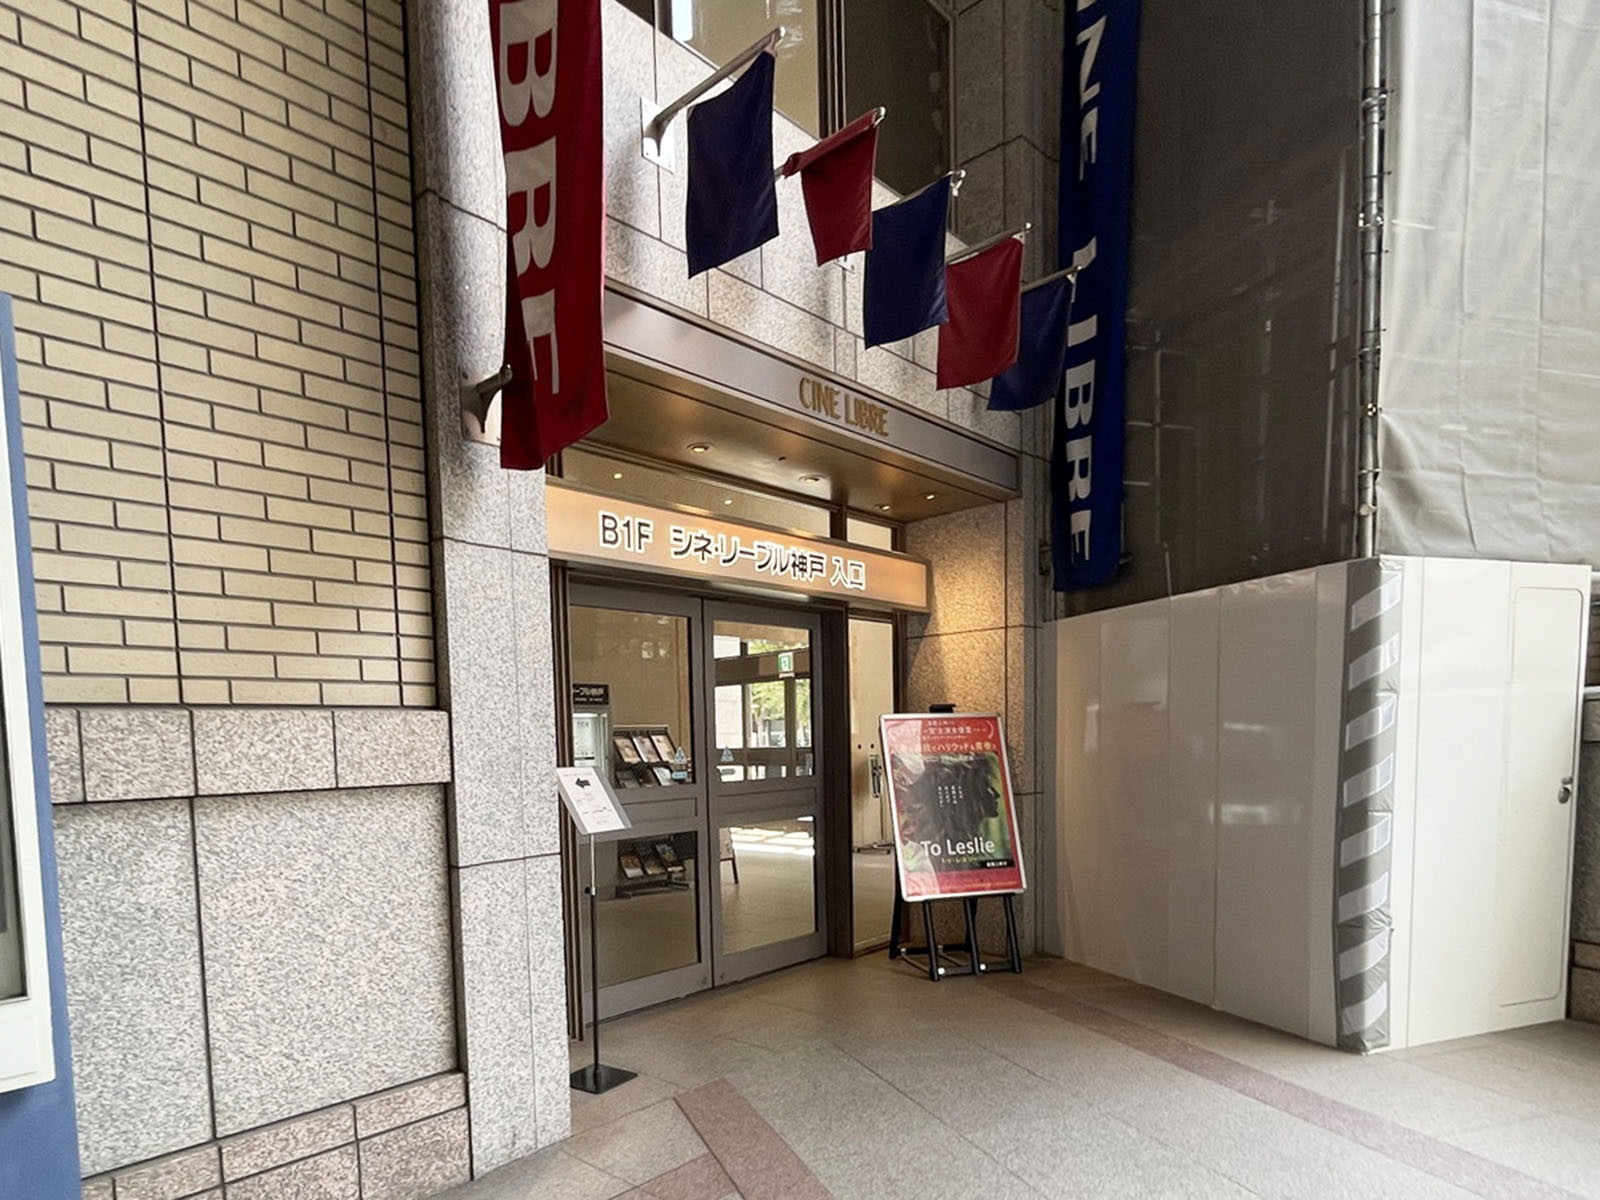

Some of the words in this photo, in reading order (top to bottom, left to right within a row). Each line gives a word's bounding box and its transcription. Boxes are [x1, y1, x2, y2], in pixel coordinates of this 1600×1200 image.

[1075, 0, 1107, 182] NE
[799, 376, 840, 420] CINE
[844, 393, 889, 437] LIBRE
[1065, 236, 1098, 564] LIBRE
[599, 512, 652, 552] B1F
[671, 525, 826, 580] シネ・リーブル神戸
[830, 558, 867, 590] 入口
[919, 840, 942, 857] To
[946, 836, 996, 856] Leslie
